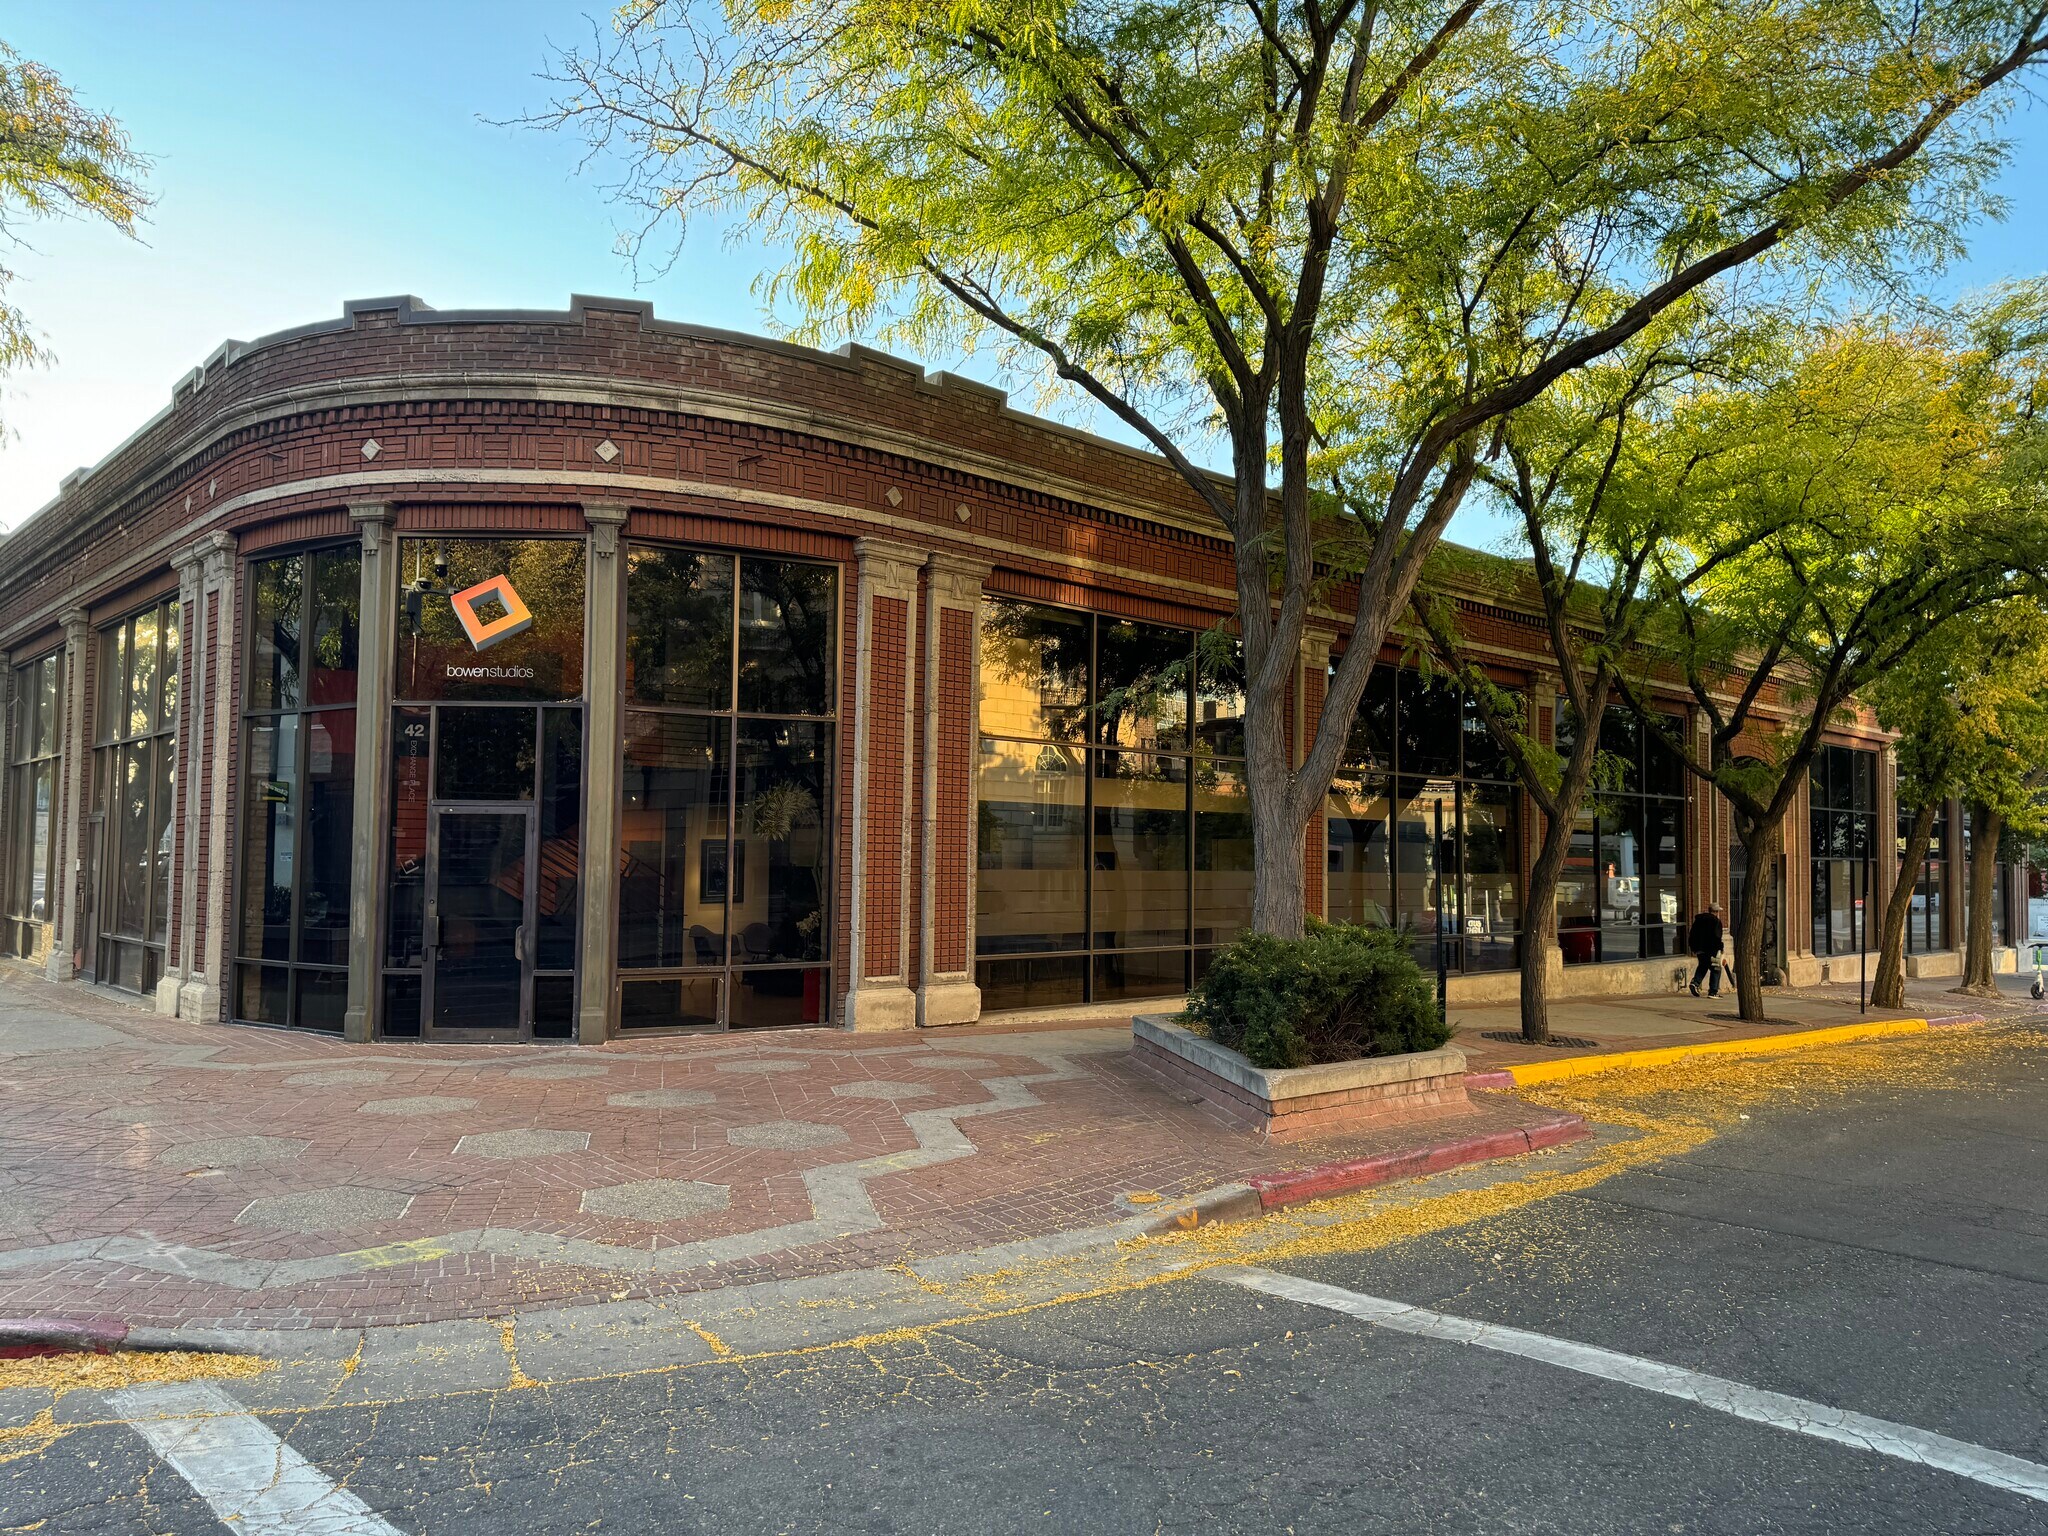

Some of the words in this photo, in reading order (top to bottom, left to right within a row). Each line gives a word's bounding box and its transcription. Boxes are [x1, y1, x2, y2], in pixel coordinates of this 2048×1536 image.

[446, 664, 534, 678] bowenstudios
[404, 723, 425, 737] 42
[409, 740, 418, 778] EXCHANGE
[408, 780, 416, 803] PLACE
